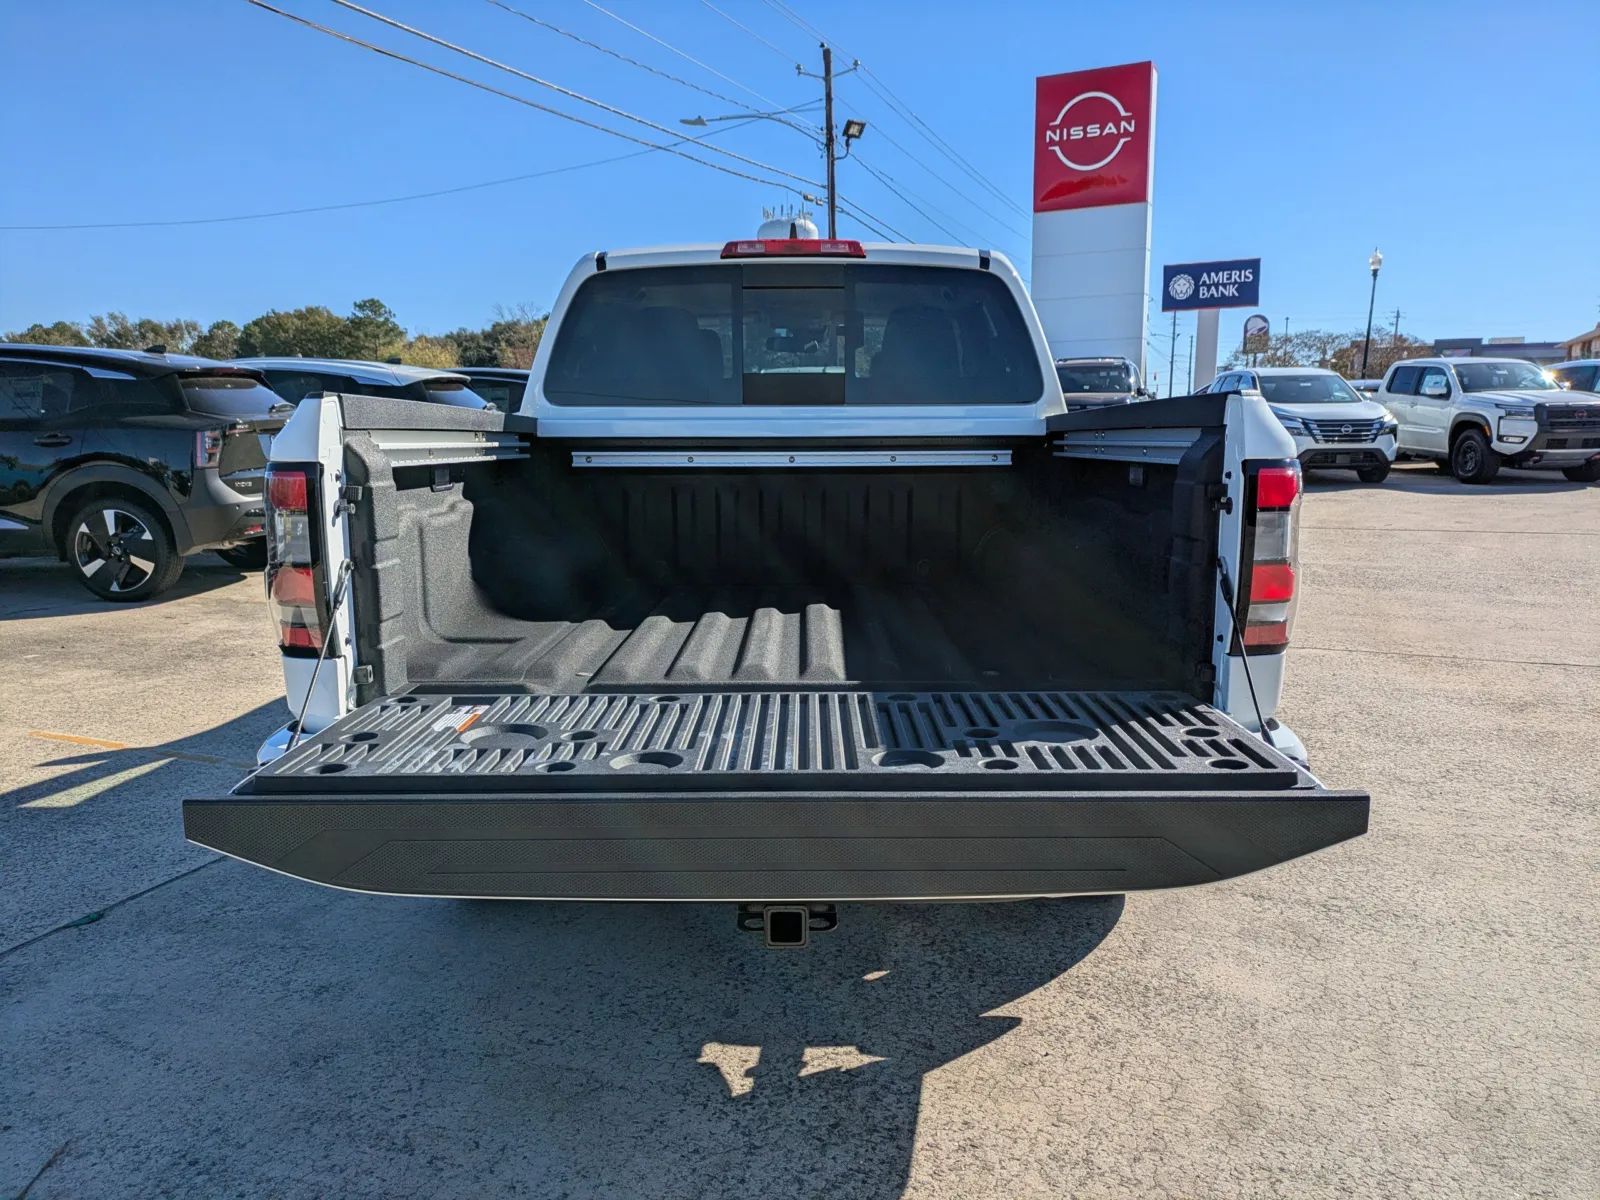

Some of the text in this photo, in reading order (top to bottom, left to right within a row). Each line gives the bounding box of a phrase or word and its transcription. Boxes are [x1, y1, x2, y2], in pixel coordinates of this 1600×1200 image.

[1046, 120, 1135, 143] NISSAN
[1199, 269, 1253, 285] AMERIS
[1199, 284, 1239, 299] BANK
